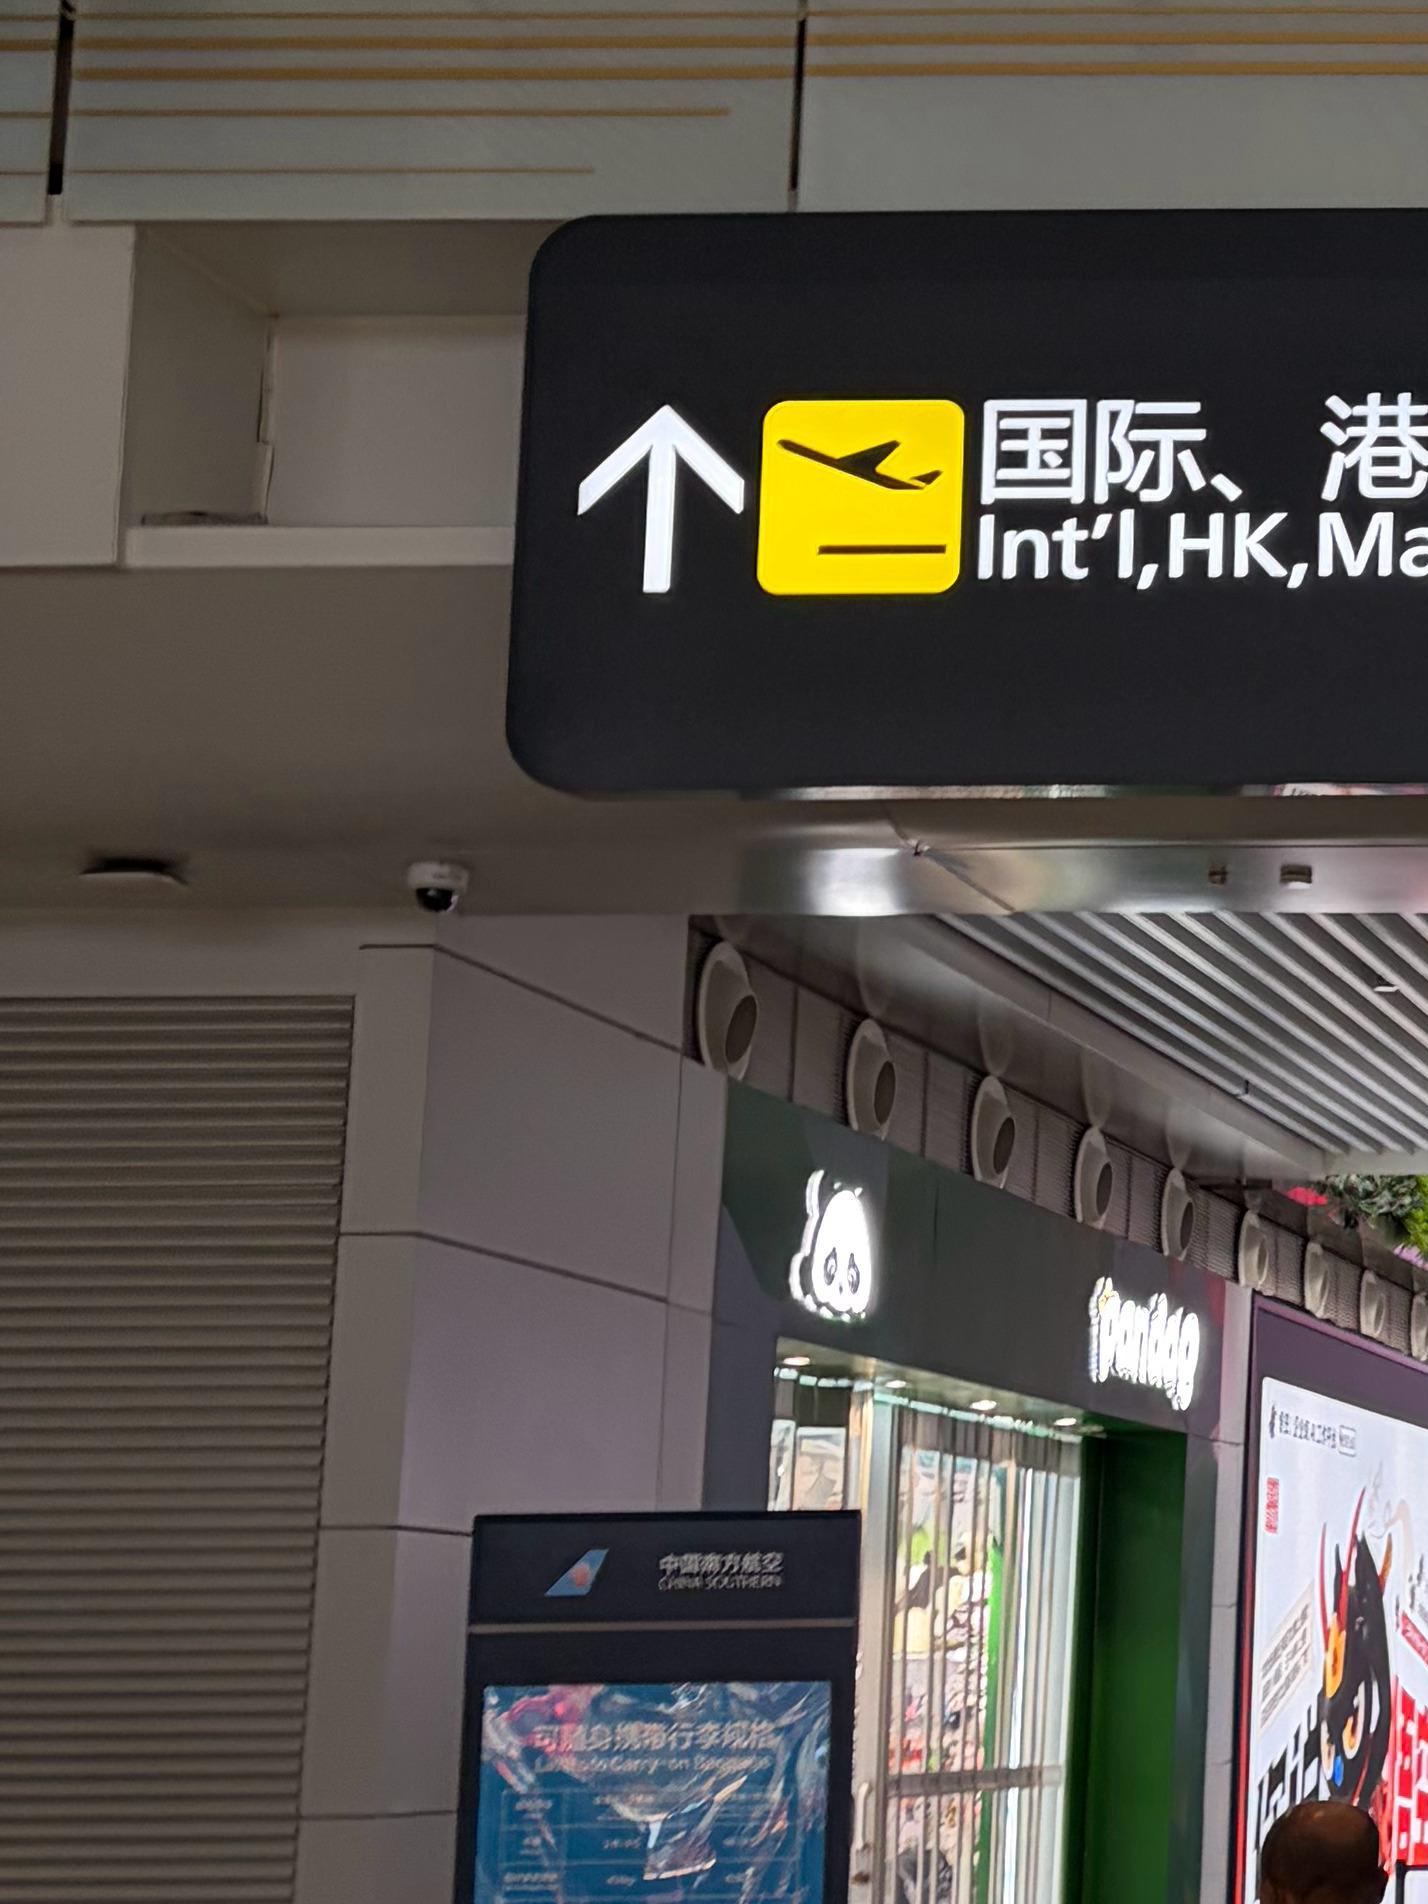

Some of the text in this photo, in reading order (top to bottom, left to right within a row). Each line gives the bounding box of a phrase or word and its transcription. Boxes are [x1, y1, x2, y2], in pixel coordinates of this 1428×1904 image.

[658, 1552, 785, 1574] 中国南方航空
